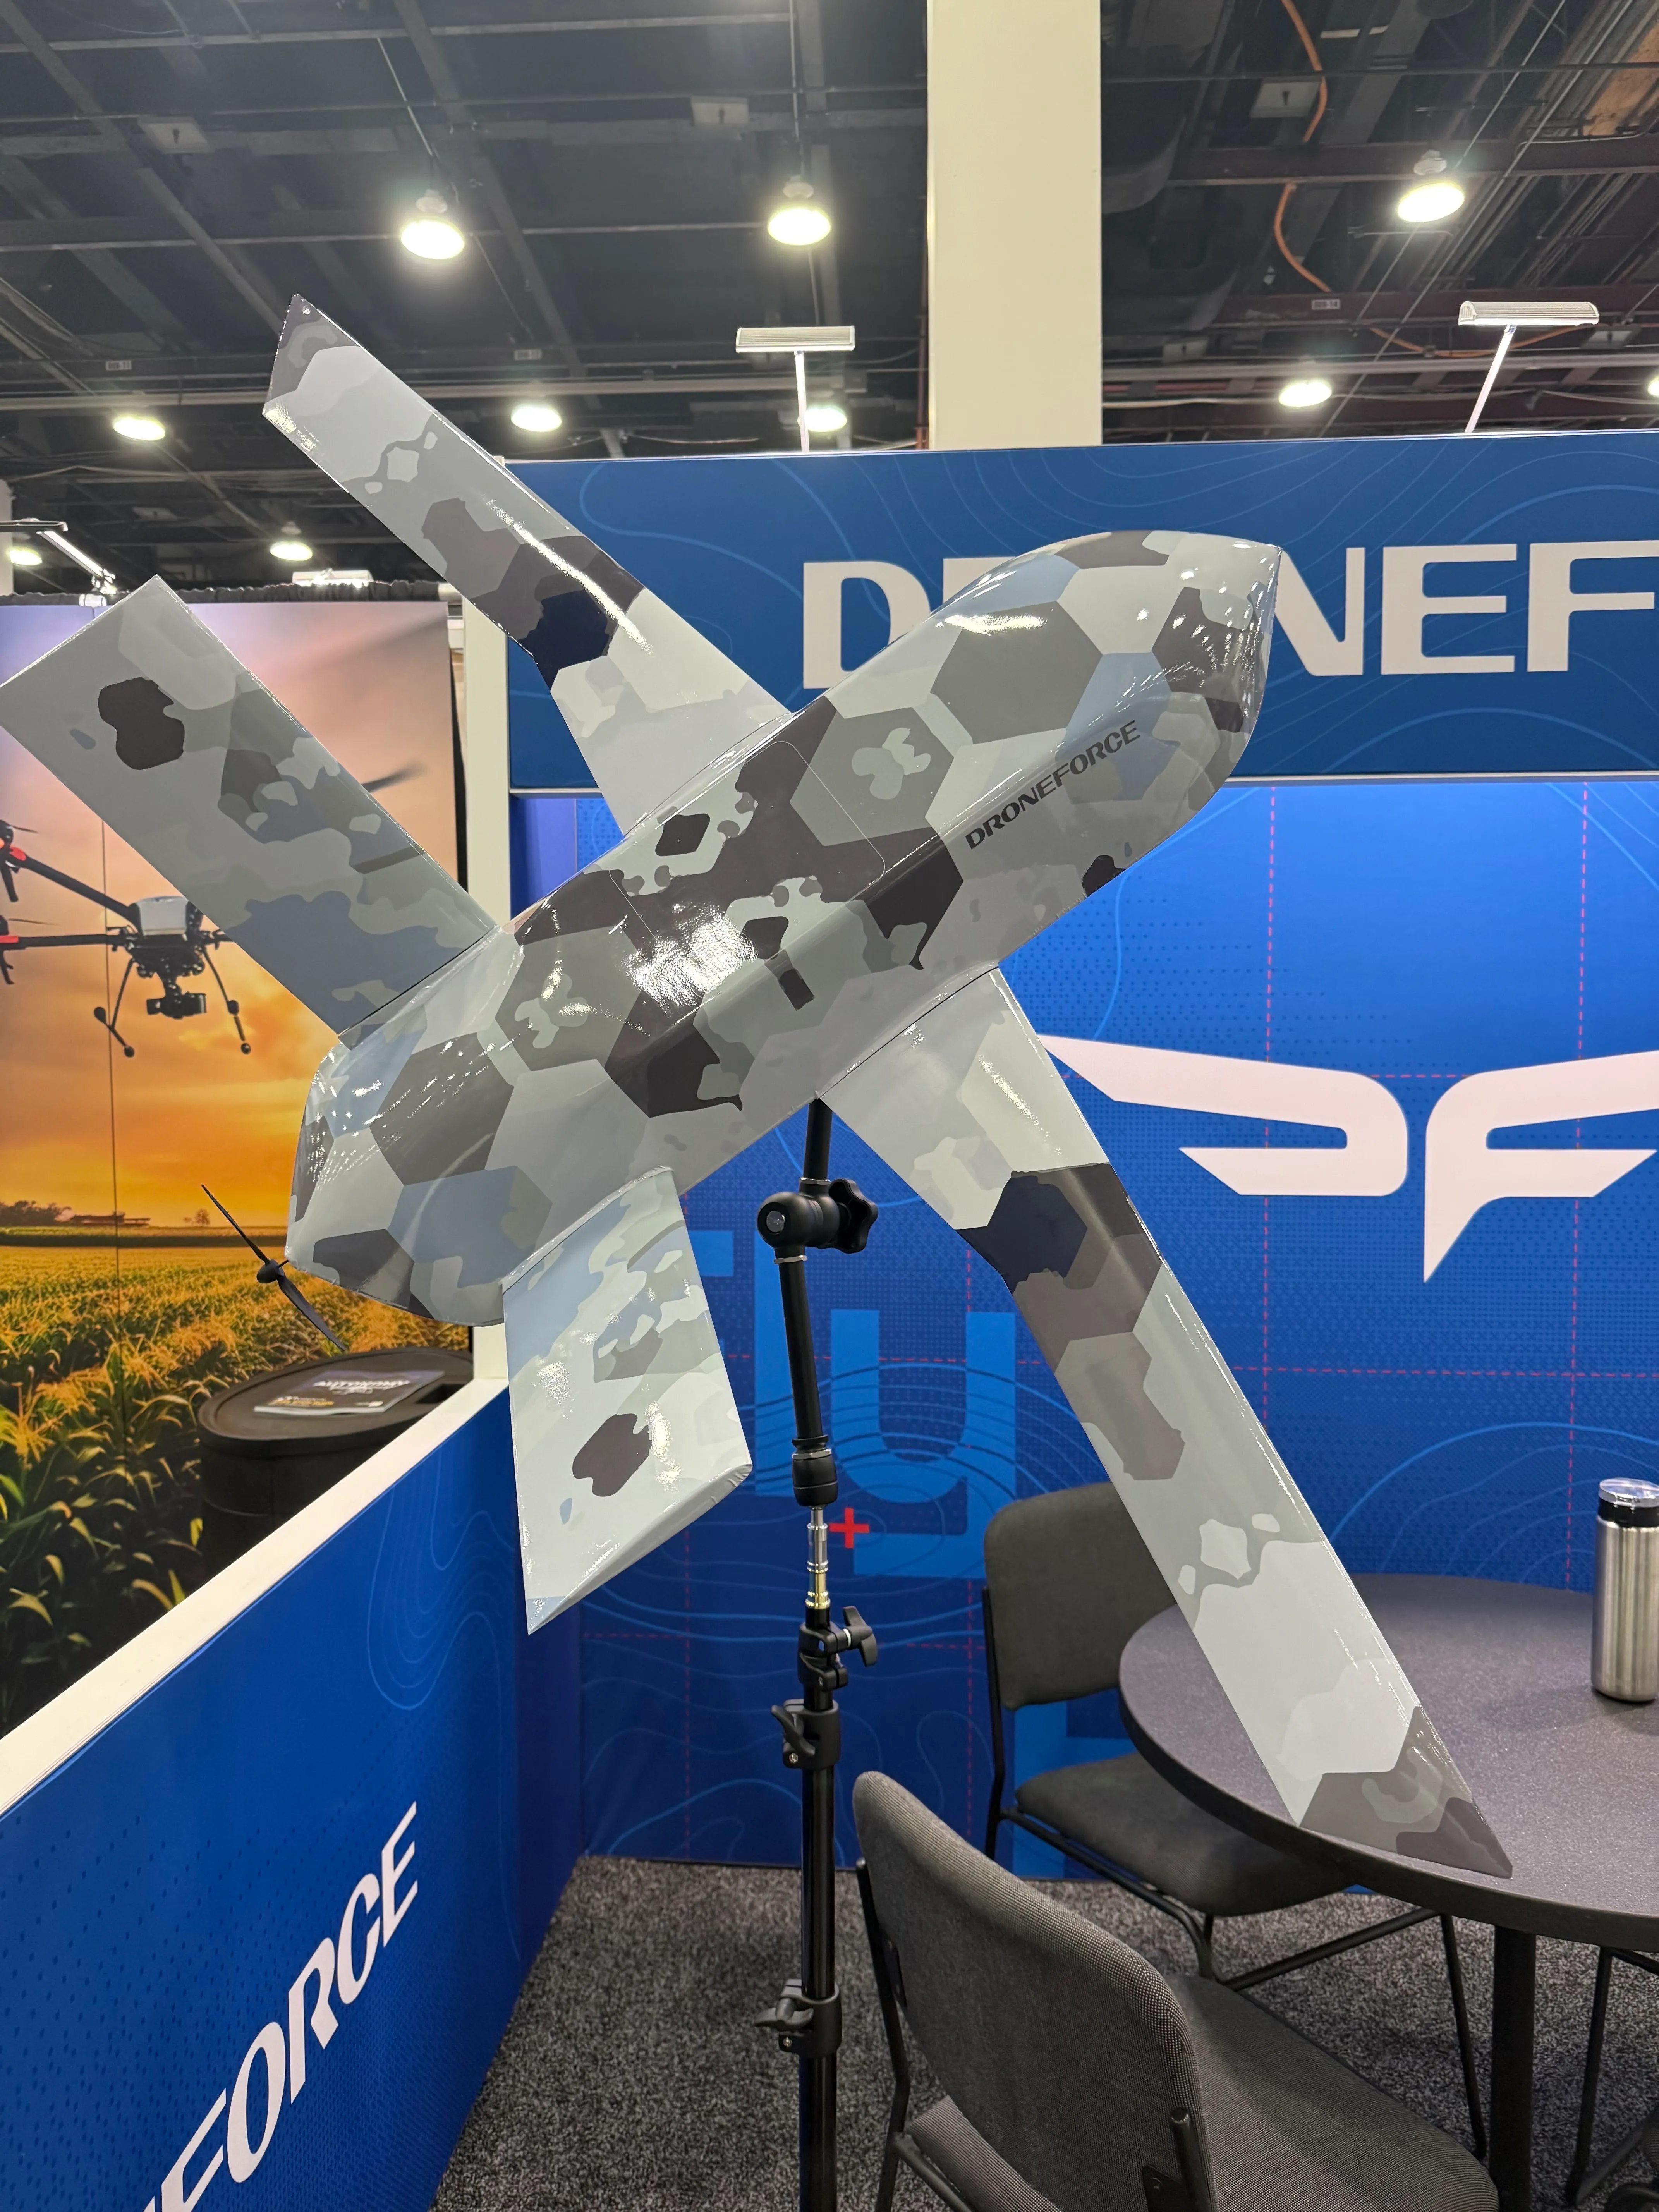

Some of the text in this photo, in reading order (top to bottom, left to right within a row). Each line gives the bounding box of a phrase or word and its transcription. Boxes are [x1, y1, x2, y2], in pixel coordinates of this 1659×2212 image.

[803, 540, 1659, 689] DNEF
[965, 720, 1140, 850] DRONEFORCE
[143, 1801, 418, 2212] FORCE
